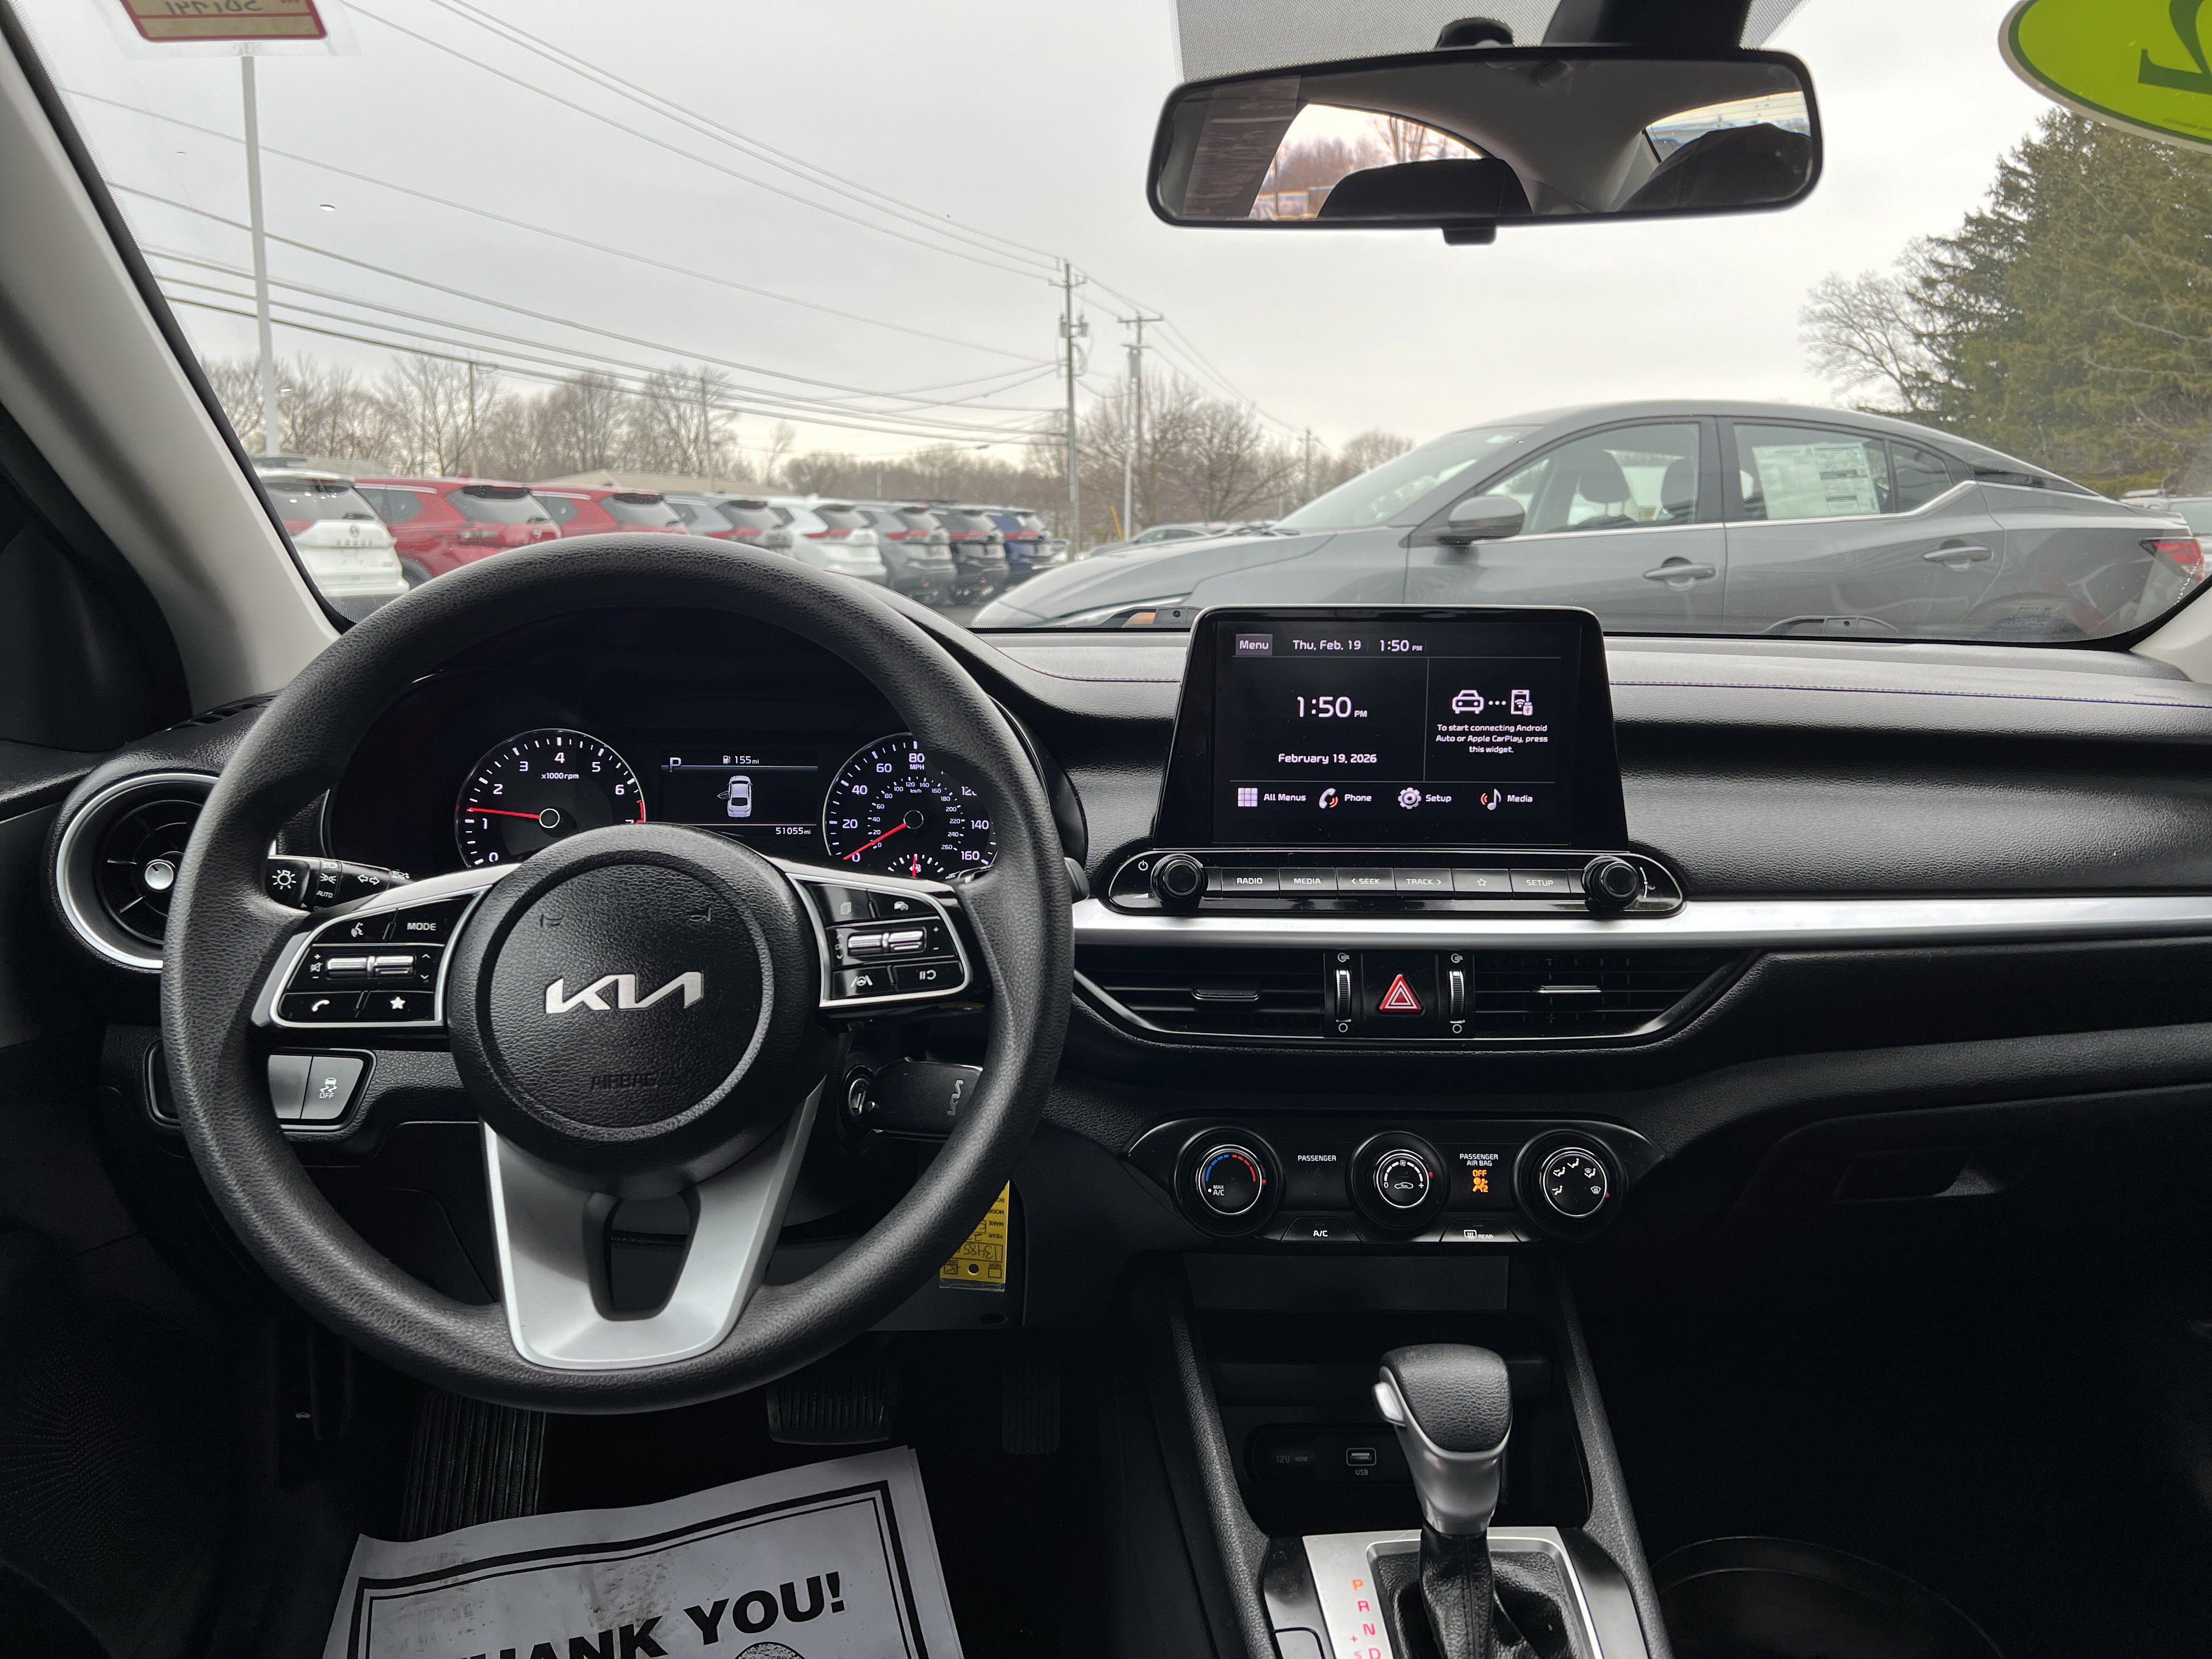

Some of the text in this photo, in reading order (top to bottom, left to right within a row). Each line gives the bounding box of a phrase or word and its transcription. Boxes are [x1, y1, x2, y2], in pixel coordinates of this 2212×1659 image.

[1239, 640, 1269, 650] Menu
[1348, 640, 1362, 650] 19
[1379, 639, 1410, 652] 1:50
[1297, 696, 1352, 718] 1:50
[1470, 724, 1515, 733] connecting
[1467, 735, 1491, 743] Apple
[554, 752, 565, 764] 4
[909, 753, 925, 763] 80
[1278, 753, 1378, 764] February 19, 2026
[518, 761, 529, 772] 3
[591, 761, 601, 772] 5
[669, 757, 682, 772] P
[876, 763, 893, 774] 60
[493, 783, 503, 795] 2
[614, 785, 625, 795] 6
[851, 785, 868, 795] 40
[1263, 793, 1306, 802] All Menus
[1344, 794, 1372, 802] Phone
[1425, 794, 1452, 804] Setup
[482, 818, 488, 830] 1
[842, 819, 858, 829] 20
[970, 820, 989, 830] 140
[489, 851, 499, 862] 0
[851, 852, 860, 862] 0
[961, 850, 980, 861] 160
[317, 890, 334, 899] AUTO
[407, 922, 437, 931] MODE
[957, 1243, 997, 1261] 13485
[1352, 1579, 1363, 1591] P
[460, 1571, 845, 1659] ANK YOU!
[1363, 1623, 1375, 1635] N
